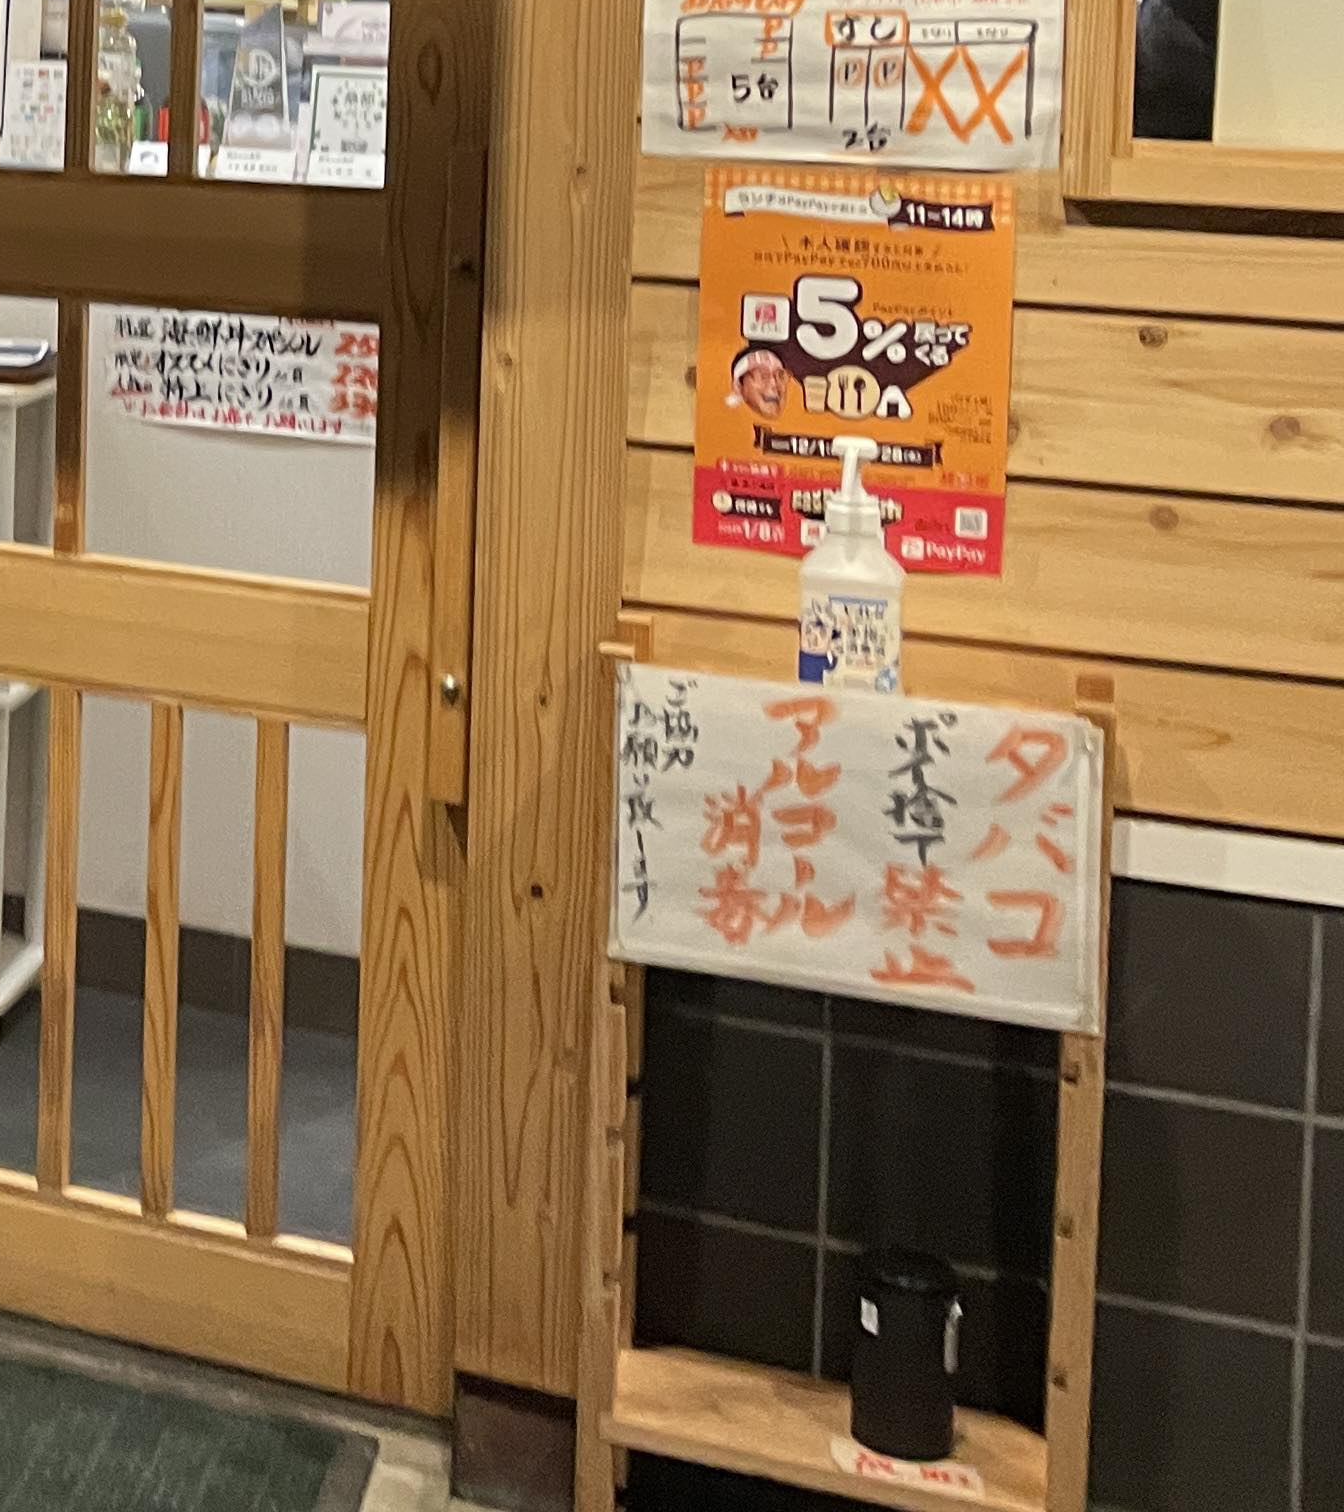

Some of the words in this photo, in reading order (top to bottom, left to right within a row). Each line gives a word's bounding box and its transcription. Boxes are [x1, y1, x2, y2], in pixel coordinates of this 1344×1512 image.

[731, 72, 780, 104] 5台
[794, 275, 907, 364] 5%
[693, 780, 769, 948] 消毒
[756, 695, 858, 939] アルコール
[967, 725, 1075, 958] タバコ
